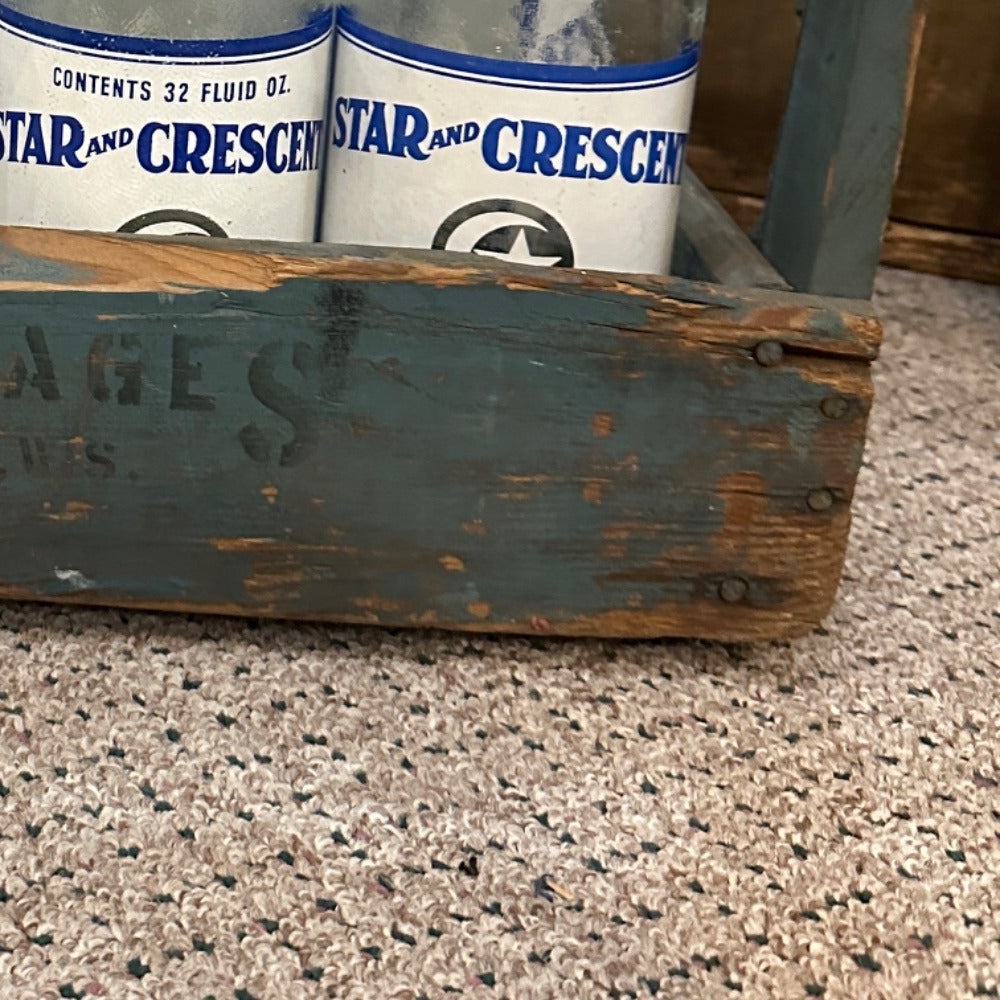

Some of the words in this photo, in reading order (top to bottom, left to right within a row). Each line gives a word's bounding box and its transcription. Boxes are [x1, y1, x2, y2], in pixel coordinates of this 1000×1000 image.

[53, 66, 152, 102] CONTENTS
[164, 81, 188, 103] 32
[201, 79, 258, 104] FLUID
[266, 73, 291, 97] OZ.
[85, 127, 134, 158] AND
[333, 96, 431, 160] STAR
[428, 122, 481, 151] AND
